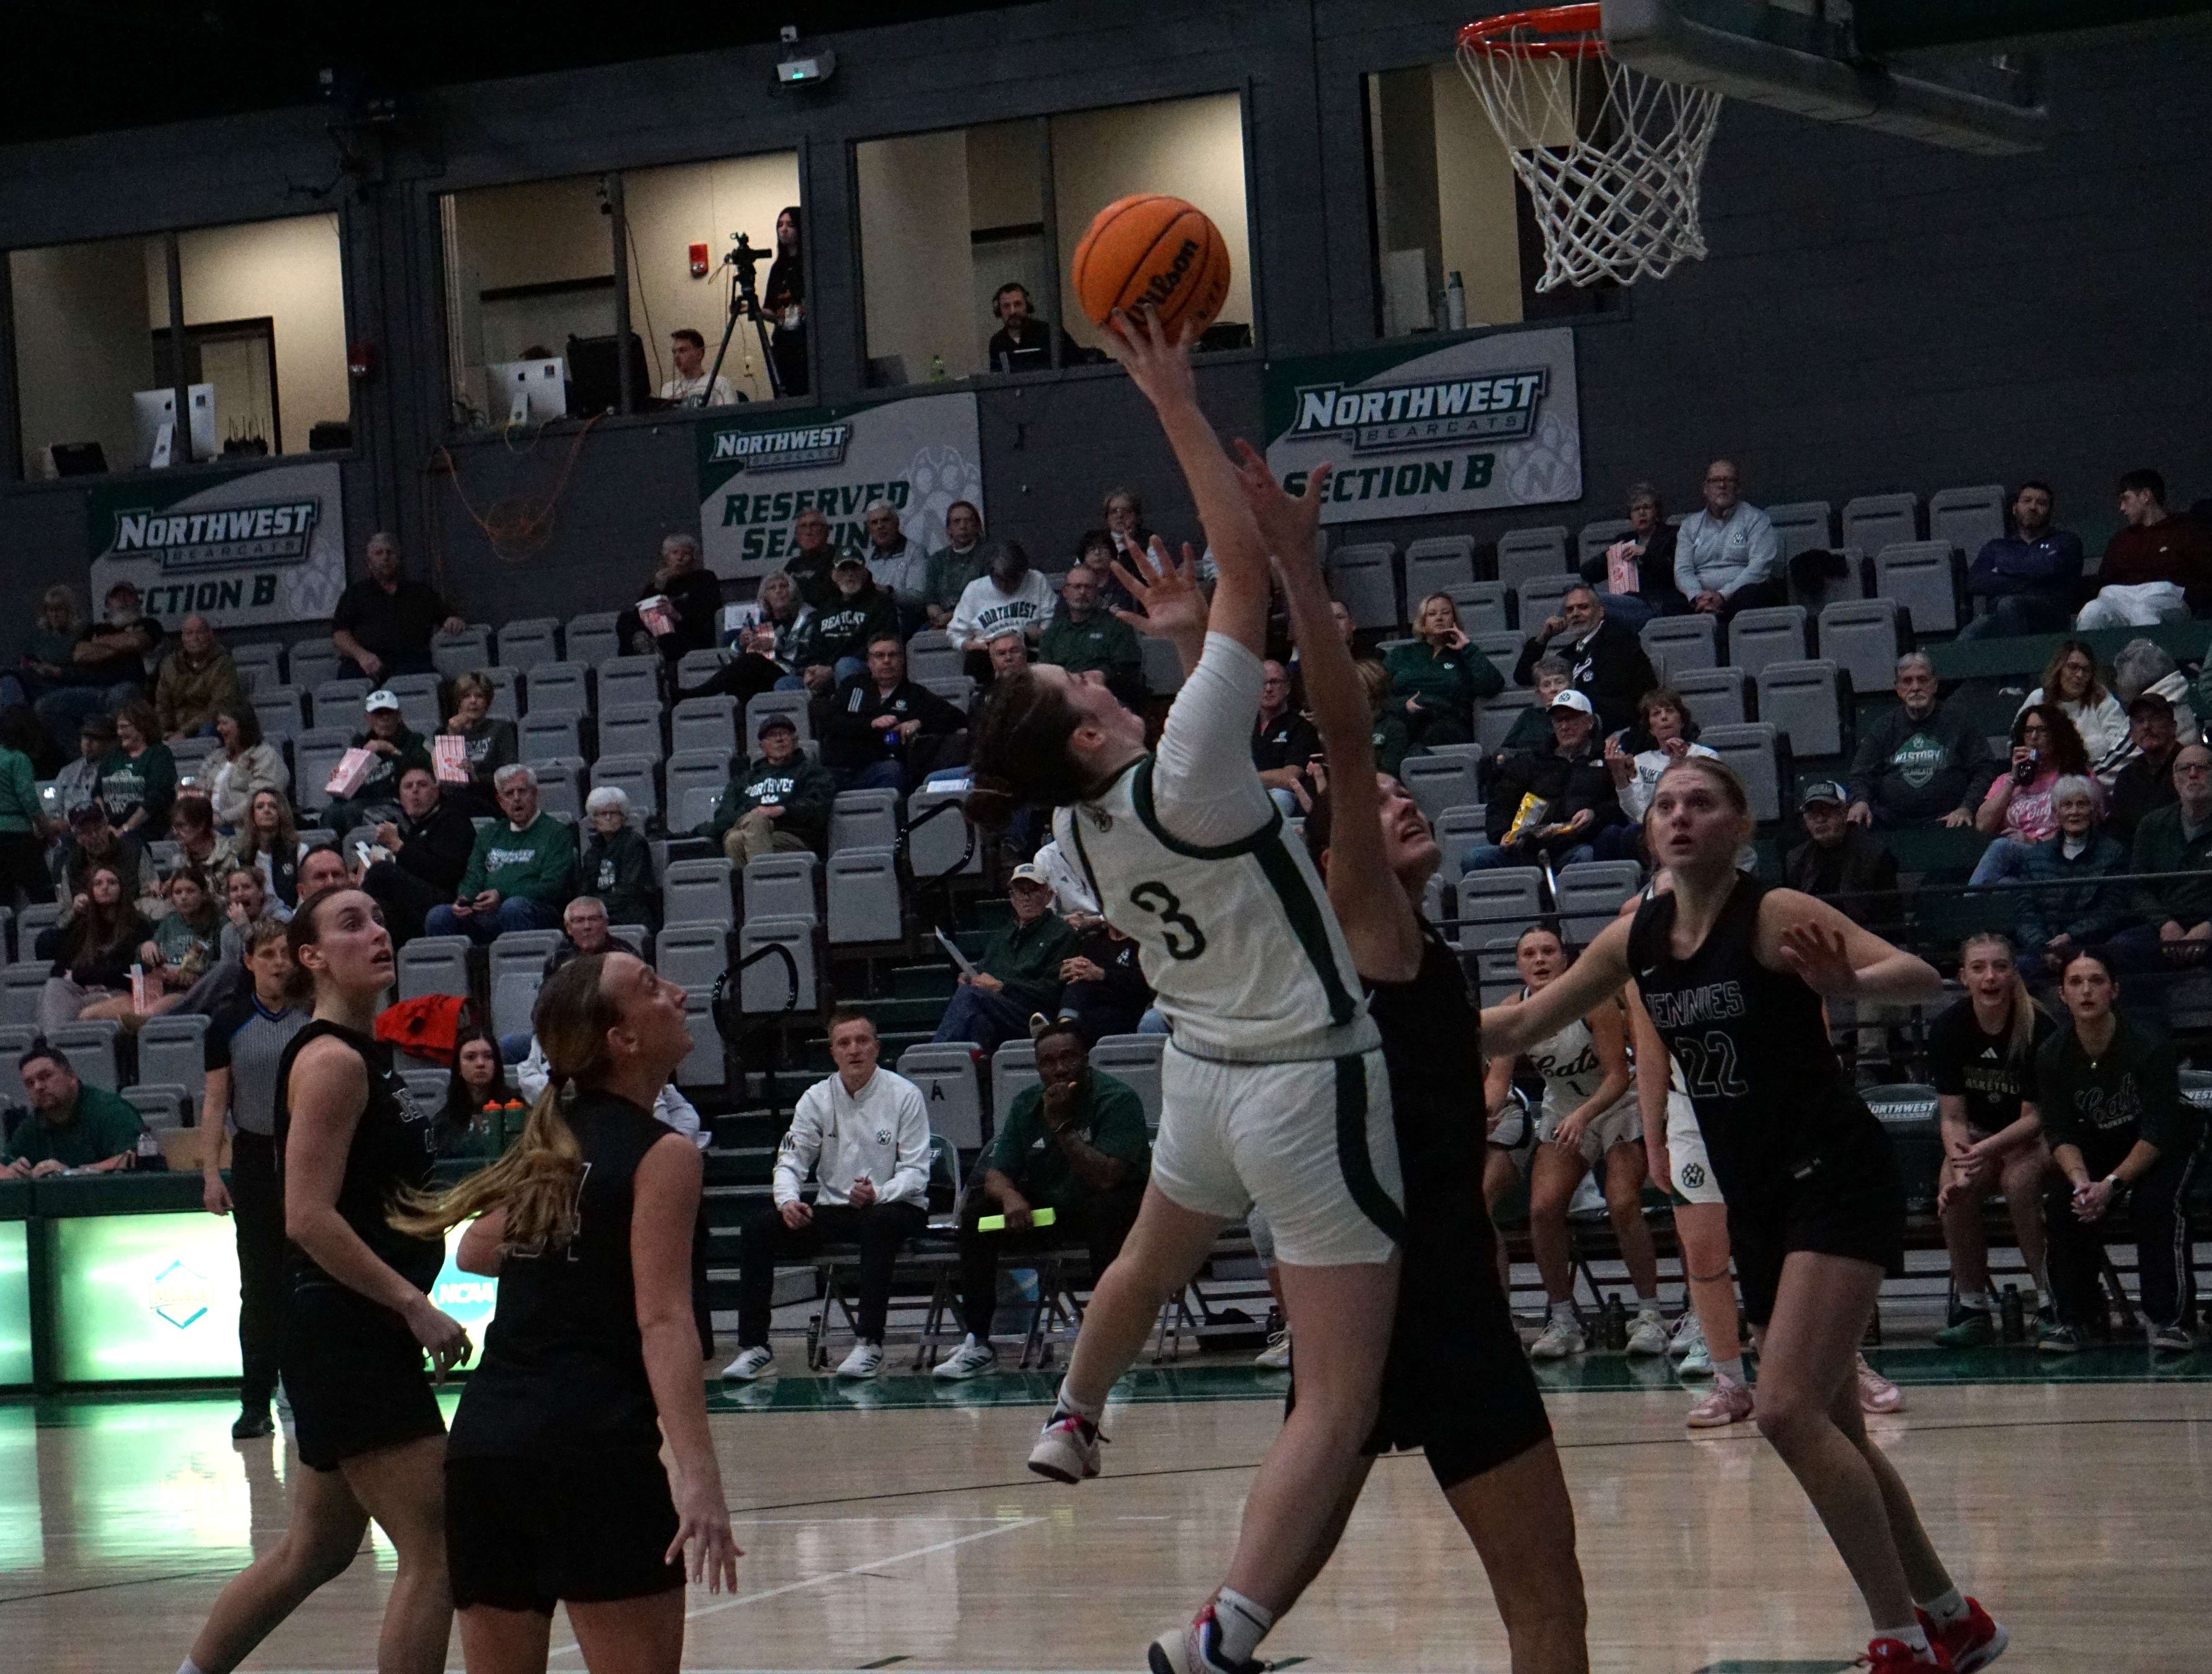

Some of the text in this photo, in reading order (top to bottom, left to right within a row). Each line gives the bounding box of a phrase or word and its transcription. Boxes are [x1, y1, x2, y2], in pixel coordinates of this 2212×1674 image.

[1298, 375, 1539, 430] NORTHWEST
[715, 426, 846, 457] NORTHWEST
[1366, 414, 1518, 442] BEARCATS
[1463, 453, 1495, 490] B
[117, 505, 313, 549] NORTHWEST
[251, 575, 277, 607] B
[978, 601, 1037, 629] NORTHWEST
[1130, 881, 1206, 958] 3
[1675, 1030, 1749, 1098] 22
[931, 1080, 944, 1101] A
[1867, 1102, 1935, 1114] ORTHWEST
[439, 1282, 494, 1304] NCAA
